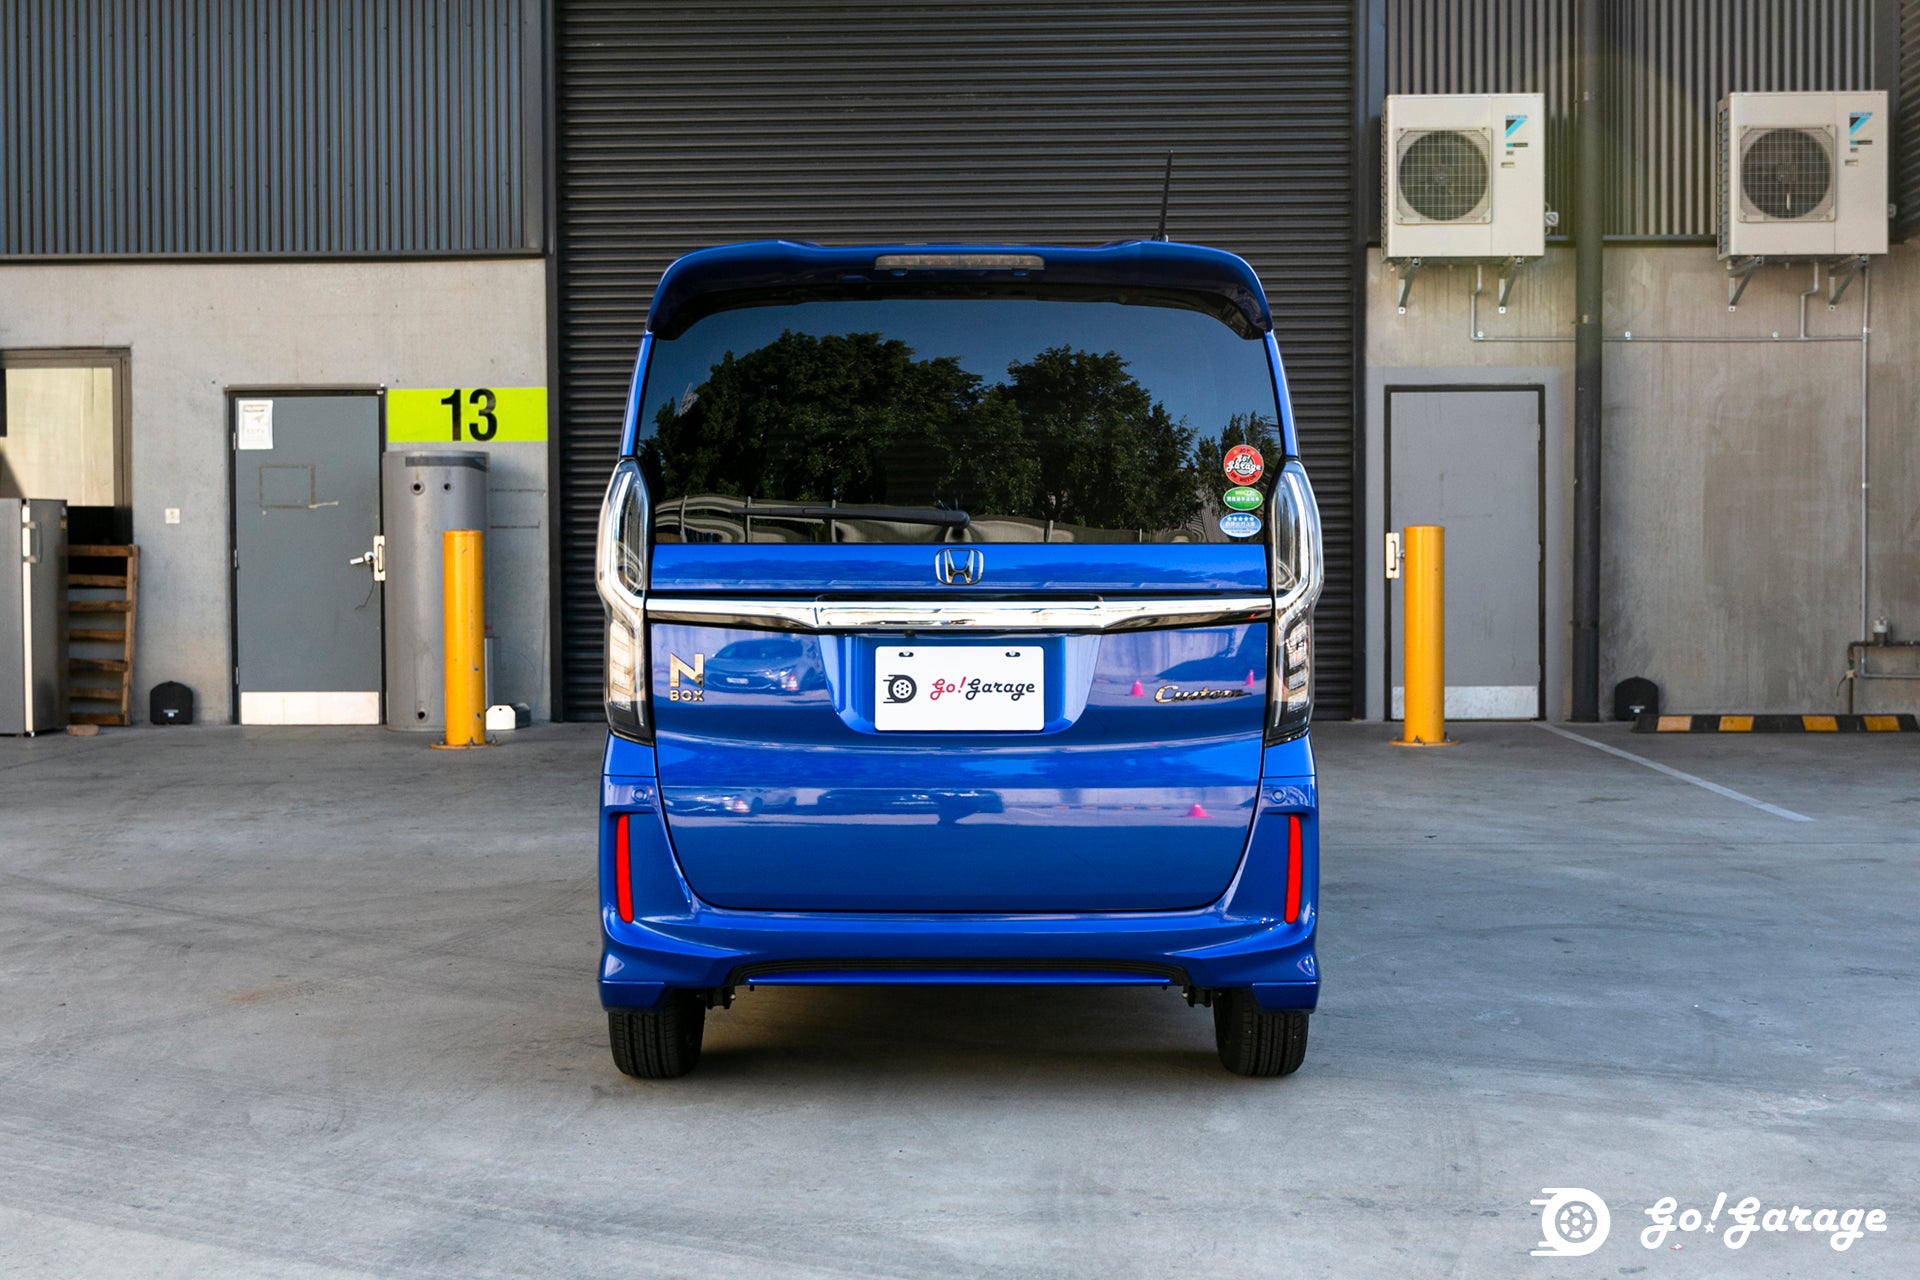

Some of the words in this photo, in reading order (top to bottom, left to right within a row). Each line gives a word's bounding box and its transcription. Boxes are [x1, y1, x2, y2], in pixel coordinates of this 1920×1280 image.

[441, 388, 498, 442] 13
[1226, 460, 1262, 474] Garage
[670, 652, 704, 688] N
[670, 689, 704, 702] BOX
[1155, 684, 1252, 704] Custom
